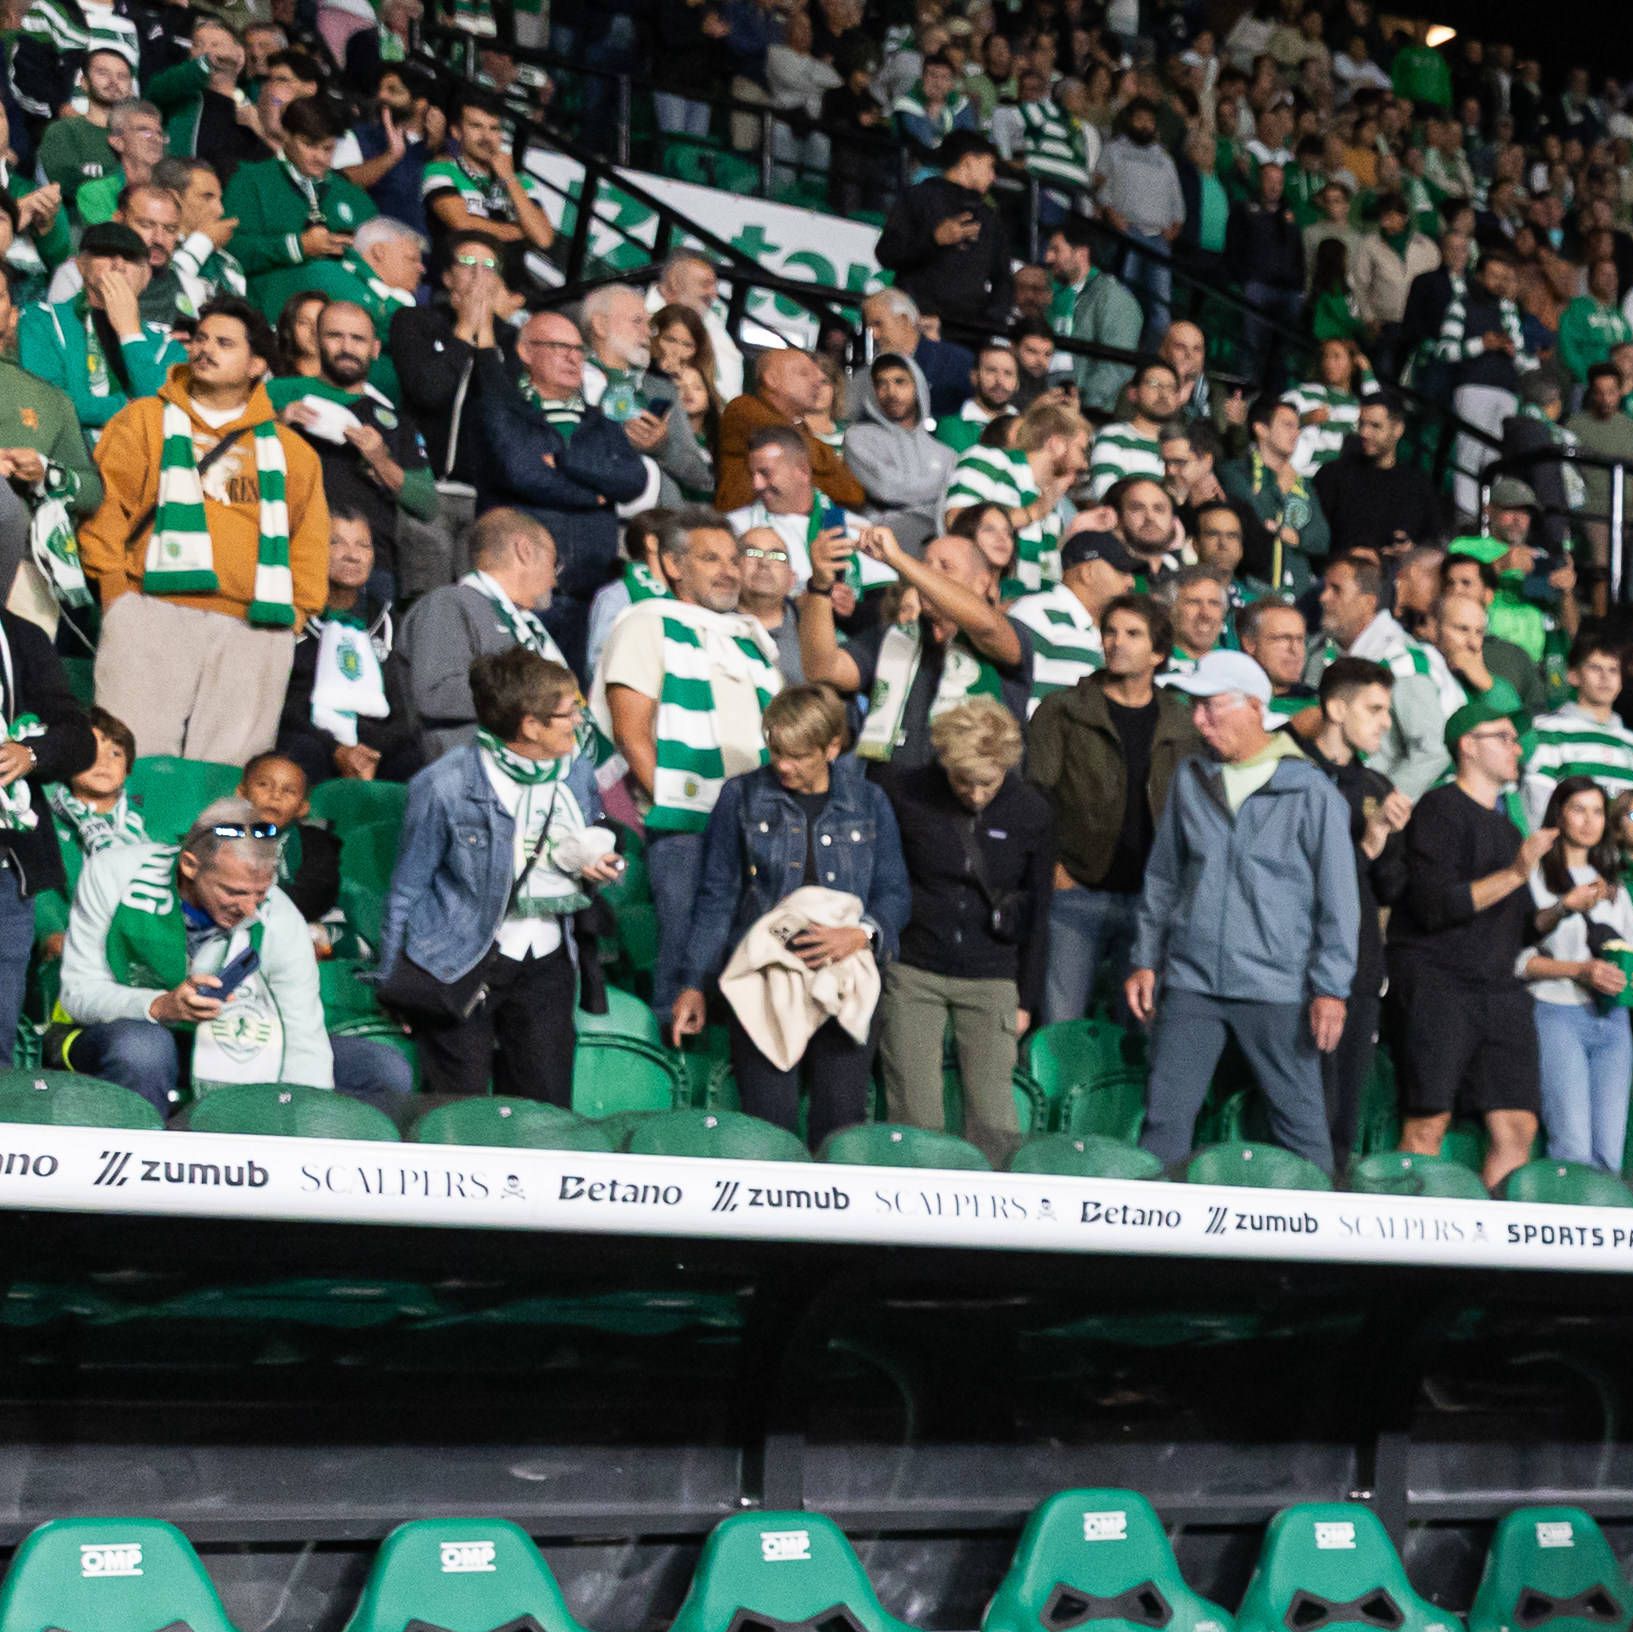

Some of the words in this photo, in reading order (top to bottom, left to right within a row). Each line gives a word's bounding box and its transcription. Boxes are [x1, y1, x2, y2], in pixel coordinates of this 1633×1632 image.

[0, 1152, 59, 1178] no
[140, 1159, 270, 1188] zumub
[301, 1163, 490, 1200] SCALPERS
[558, 1175, 683, 1206] Betano
[748, 1186, 851, 1211] zumub
[875, 1189, 1027, 1219] SCALPERS
[1080, 1201, 1182, 1229] Betano
[1235, 1212, 1319, 1235] zumub
[1507, 1223, 1604, 1247] SPORTS
[80, 1548, 144, 1573] OMP
[441, 1546, 496, 1568] OMP
